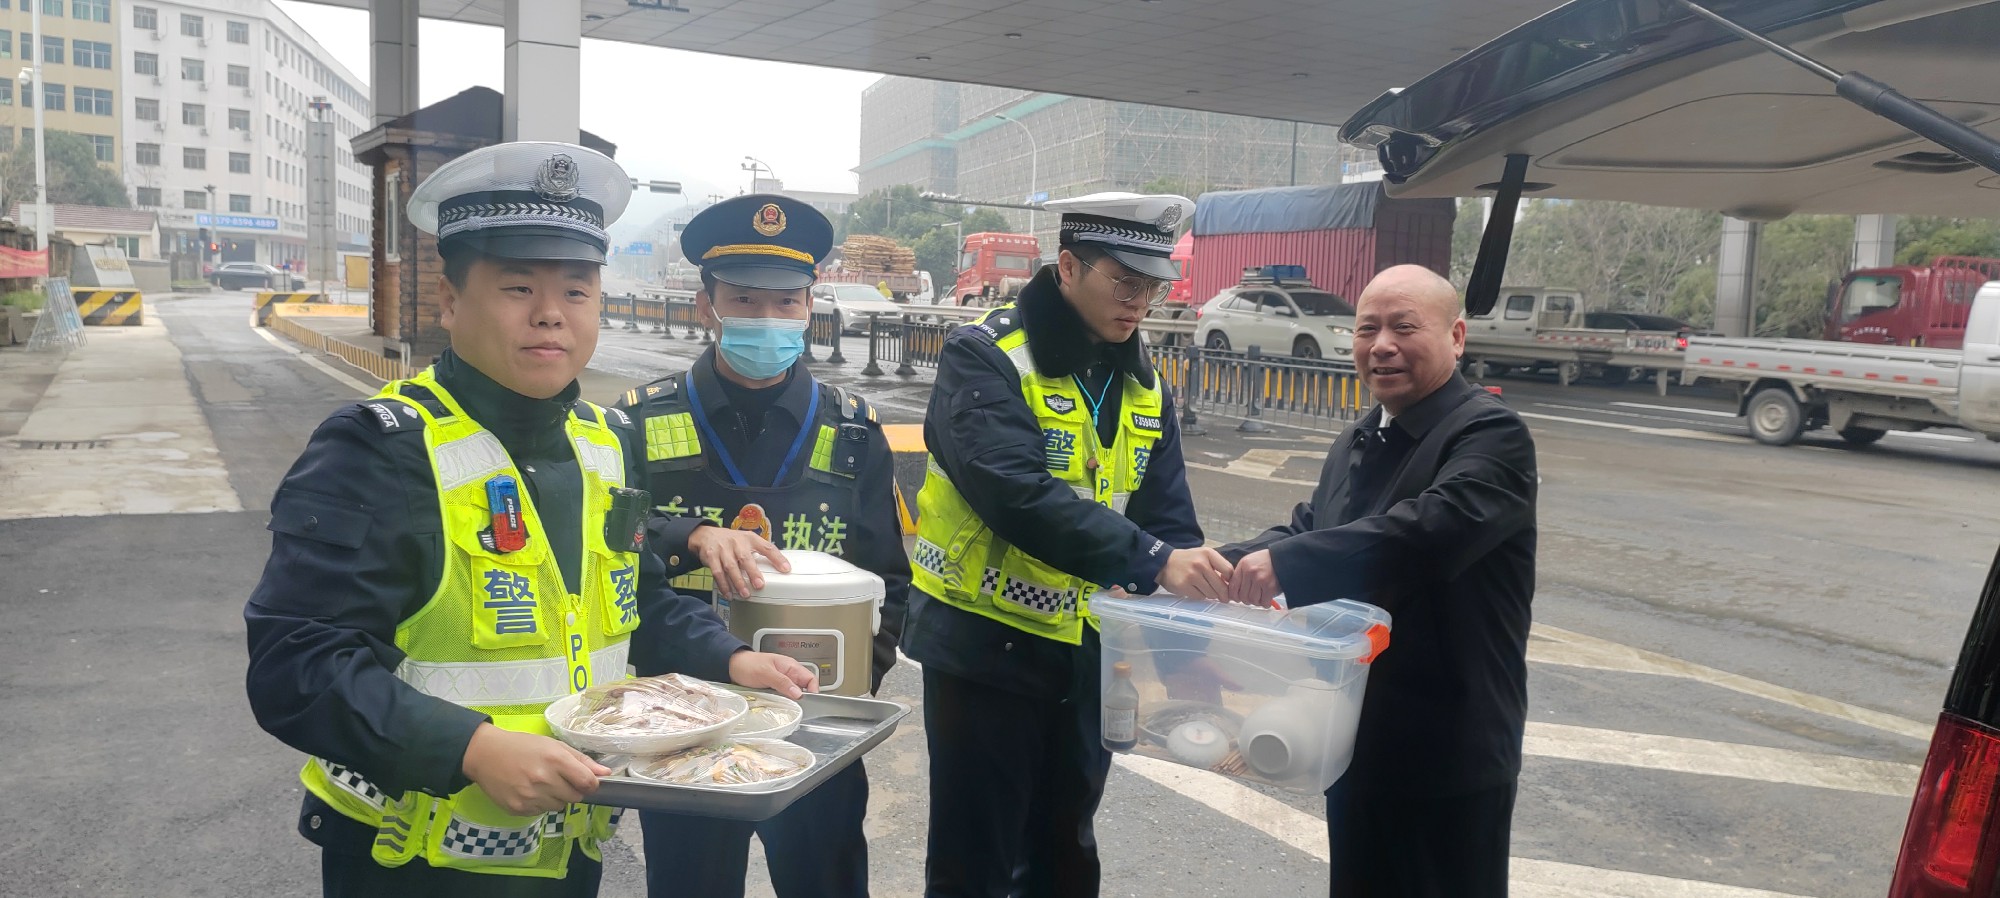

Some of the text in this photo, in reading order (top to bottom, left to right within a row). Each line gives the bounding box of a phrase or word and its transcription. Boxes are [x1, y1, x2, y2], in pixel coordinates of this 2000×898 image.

[507, 497, 517, 528] POLICE
[782, 513, 847, 557] 执法
[1148, 539, 1164, 556] POLIC
